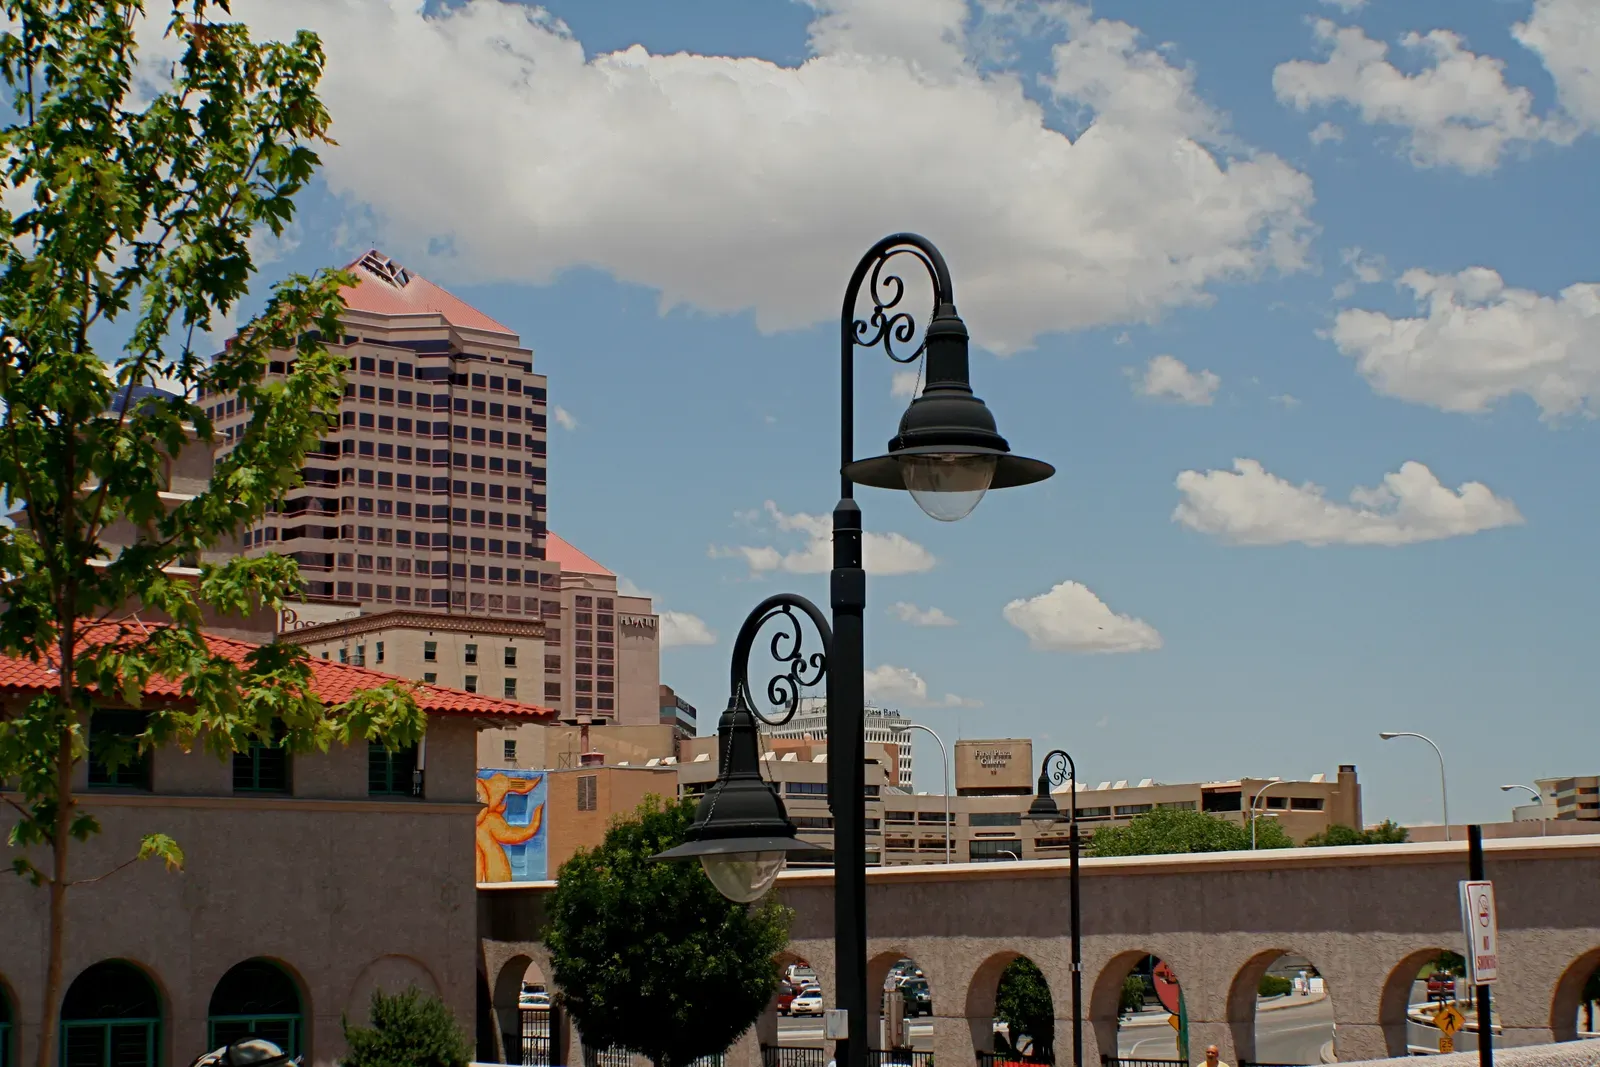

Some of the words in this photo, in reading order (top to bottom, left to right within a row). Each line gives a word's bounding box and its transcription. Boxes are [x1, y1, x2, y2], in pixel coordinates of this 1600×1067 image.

[620, 615, 656, 628] HYATT
[883, 708, 900, 716] Bank
[1483, 936, 1489, 950] NO
[1477, 955, 1496, 970] SMOKING
